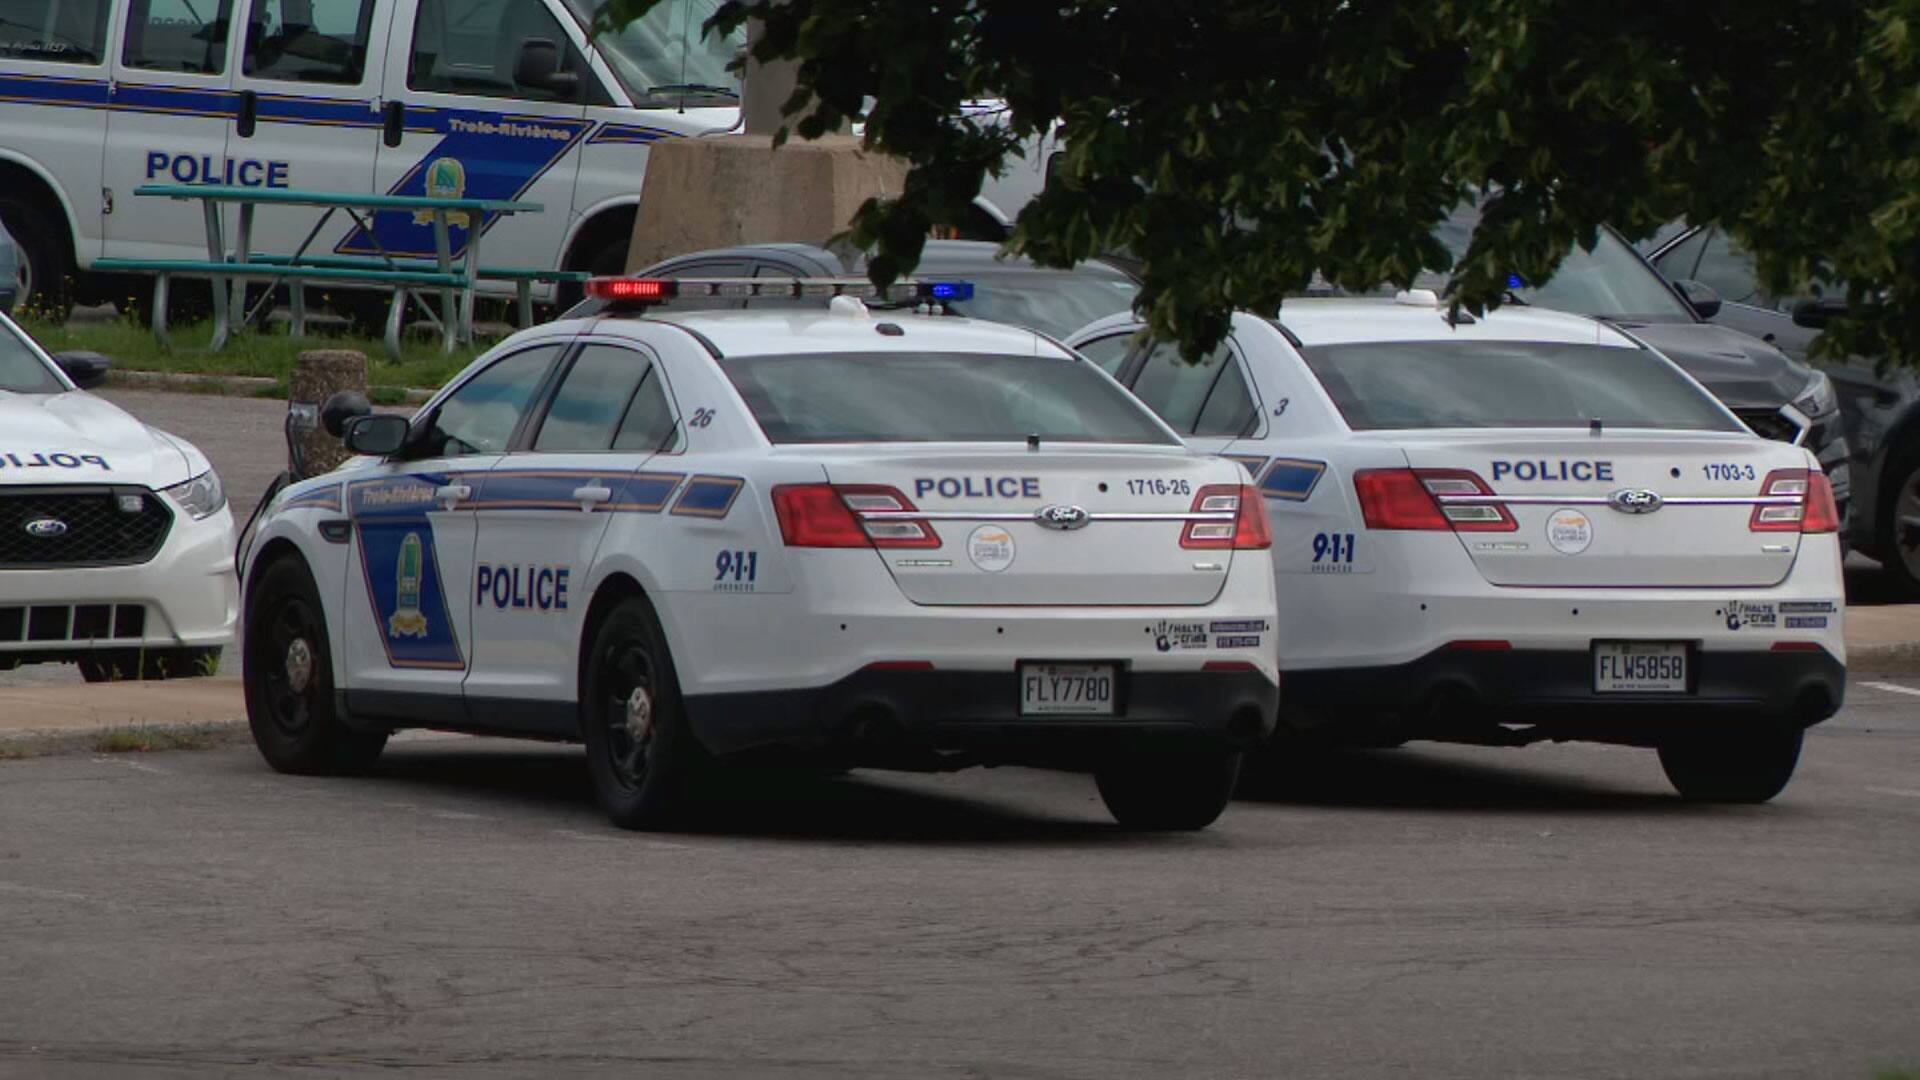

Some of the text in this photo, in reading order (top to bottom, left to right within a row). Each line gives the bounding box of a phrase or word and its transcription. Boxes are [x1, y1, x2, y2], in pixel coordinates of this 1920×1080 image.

[147, 151, 289, 188] POLICE
[689, 407, 716, 428] 26
[1274, 398, 1289, 416] 3
[1492, 461, 1614, 481] POLICE
[1702, 464, 1755, 480] 1703-3
[915, 477, 1041, 498] POLICE
[1127, 479, 1190, 496] 1716-26
[477, 565, 570, 609] POLICE
[1600, 656, 1682, 679] FLW5858
[1026, 677, 1109, 701] FLY7780
